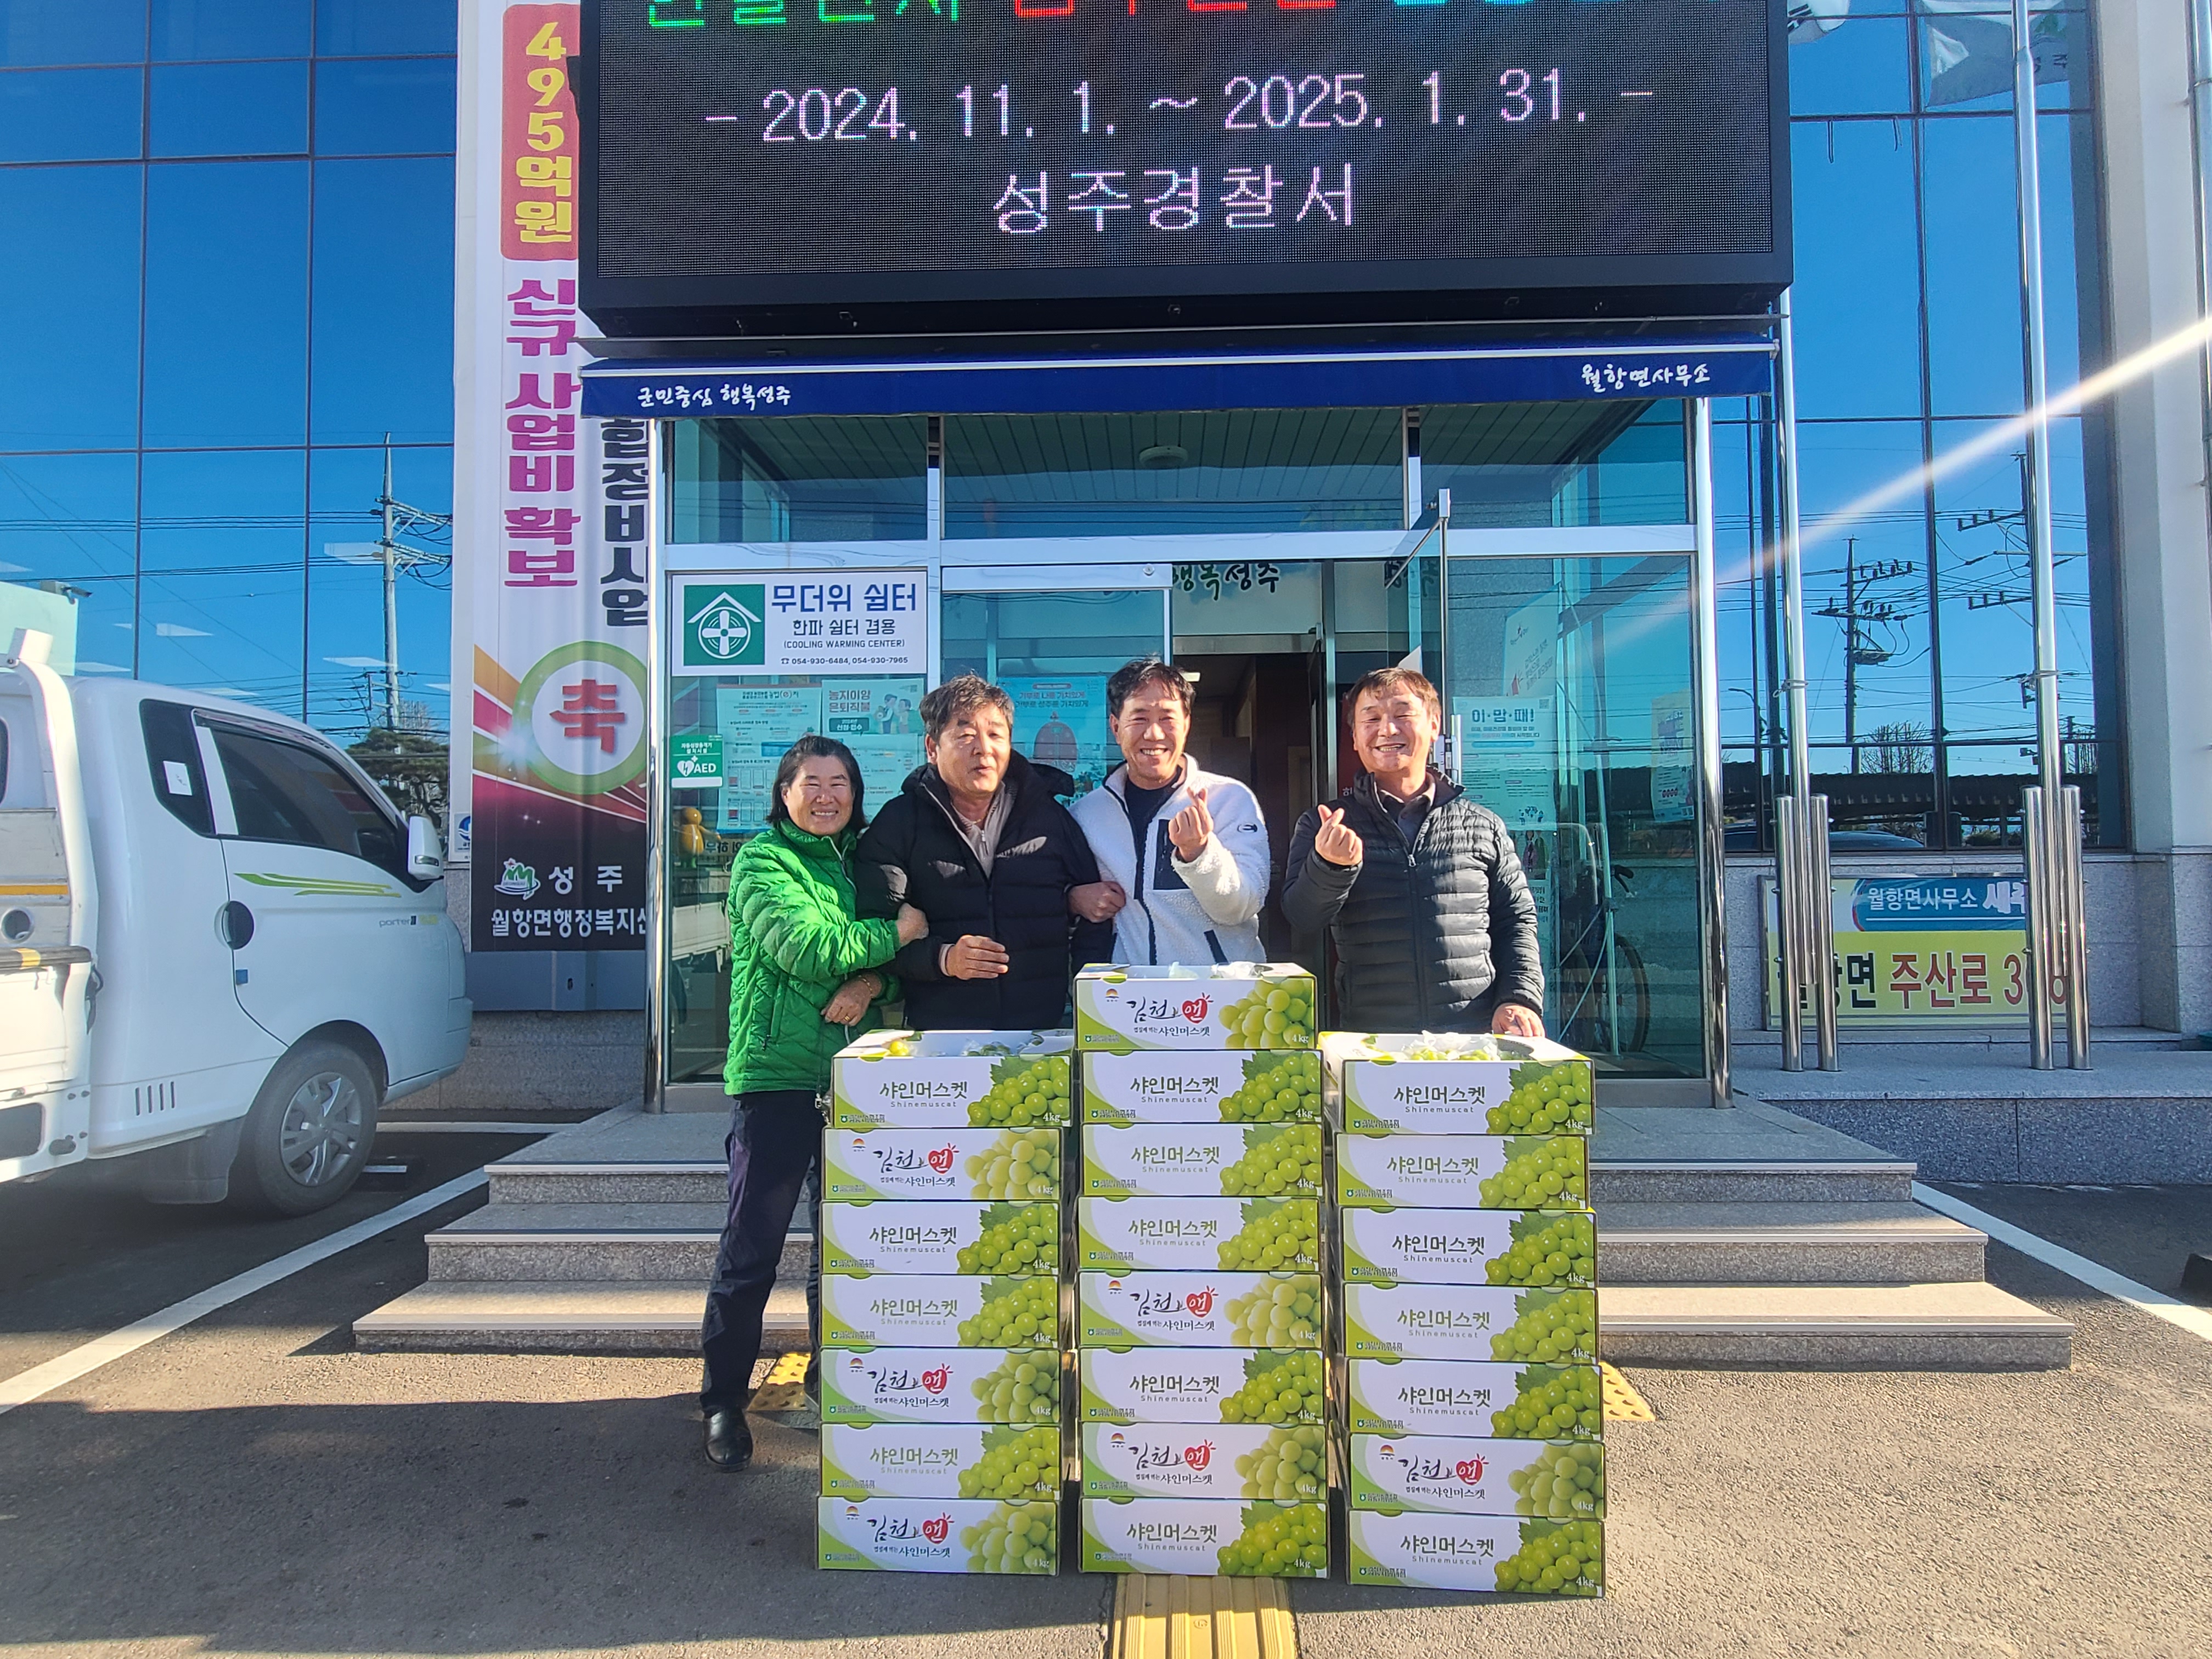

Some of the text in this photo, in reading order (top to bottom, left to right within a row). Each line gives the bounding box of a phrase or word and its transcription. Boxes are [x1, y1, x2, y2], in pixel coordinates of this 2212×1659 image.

[762, 87, 917, 141] 2024.
[956, 84, 1034, 138] 11.
[1073, 81, 1115, 135] 1.
[1225, 74, 1382, 128] 2025.
[1423, 70, 1464, 126] 1.
[1499, 68, 1585, 122] 31.
[515, 22, 572, 242] 495억원
[994, 163, 1352, 234] 성주경찰서
[1582, 364, 1710, 393] 월항면사무소
[637, 383, 791, 410] 군민중심 행복성주
[504, 279, 581, 587] 신규 사업비 확보
[772, 584, 915, 612] 무더위 쉼터
[793, 619, 895, 635] 한파 쉼터 겸용
[784, 640, 823, 648] (COOLING
[550, 679, 625, 753] 축
[693, 763, 716, 773] AED
[1867, 888, 1978, 911] 월항면사무소
[1890, 952, 1991, 1009] 주산로
[1159, 1026, 1210, 1036] 샤인머스켓
[879, 1081, 968, 1099] 샤인머스켓
[1130, 1076, 1218, 1094] 샤인머스켓
[1393, 1086, 1486, 1104] 샤인머스켓
[1043, 1113, 1060, 1122] 4kg
[1295, 1109, 1313, 1119] 4kg
[1565, 1119, 1583, 1130] 4kg
[1131, 1146, 1220, 1165] 샤인머스켓
[1387, 1156, 1479, 1175] 샤인머스켓
[905, 1177, 956, 1187] 샤인머스켓
[1297, 1179, 1314, 1189] 4kg
[1559, 1191, 1577, 1202] 4kg
[1128, 1220, 1217, 1238] 샤인머스켓
[869, 1226, 957, 1245] 샤인머스켓
[1392, 1234, 1485, 1256] 샤인머스켓
[1032, 1260, 1050, 1270] 4kg
[1295, 1254, 1312, 1264] 4kg
[1404, 1255, 1472, 1263] Shinemuscat
[1566, 1272, 1585, 1283] 4kg
[870, 1299, 958, 1317] 샤인머스켓
[1163, 1319, 1215, 1331] 샤인머스켓
[1397, 1310, 1489, 1330] 샤인머스켓
[1034, 1333, 1051, 1344] 4kg
[1571, 1348, 1589, 1358] 4kg
[1130, 1375, 1220, 1394] 샤인머스켓
[899, 1397, 949, 1408] 샤인머스켓
[1397, 1387, 1491, 1408] 샤인머스켓
[1297, 1410, 1315, 1420] 4kg
[1409, 1407, 1479, 1415] Shinemuscat
[1572, 1425, 1590, 1436] 4kg
[870, 1447, 958, 1466] 샤인머스켓
[1161, 1474, 1212, 1485] 샤인머스켓
[1035, 1482, 1052, 1492] 4kg
[1431, 1487, 1485, 1499] 샤인머스켓
[1127, 1523, 1217, 1543] 샤인머스켓
[899, 1546, 950, 1558] 샤인머스켓
[1400, 1536, 1493, 1557] 샤인머스켓
[1294, 1559, 1311, 1569] 4kg
[1413, 1556, 1482, 1565] Shinemuscat
[1576, 1576, 1594, 1587] 4kg
